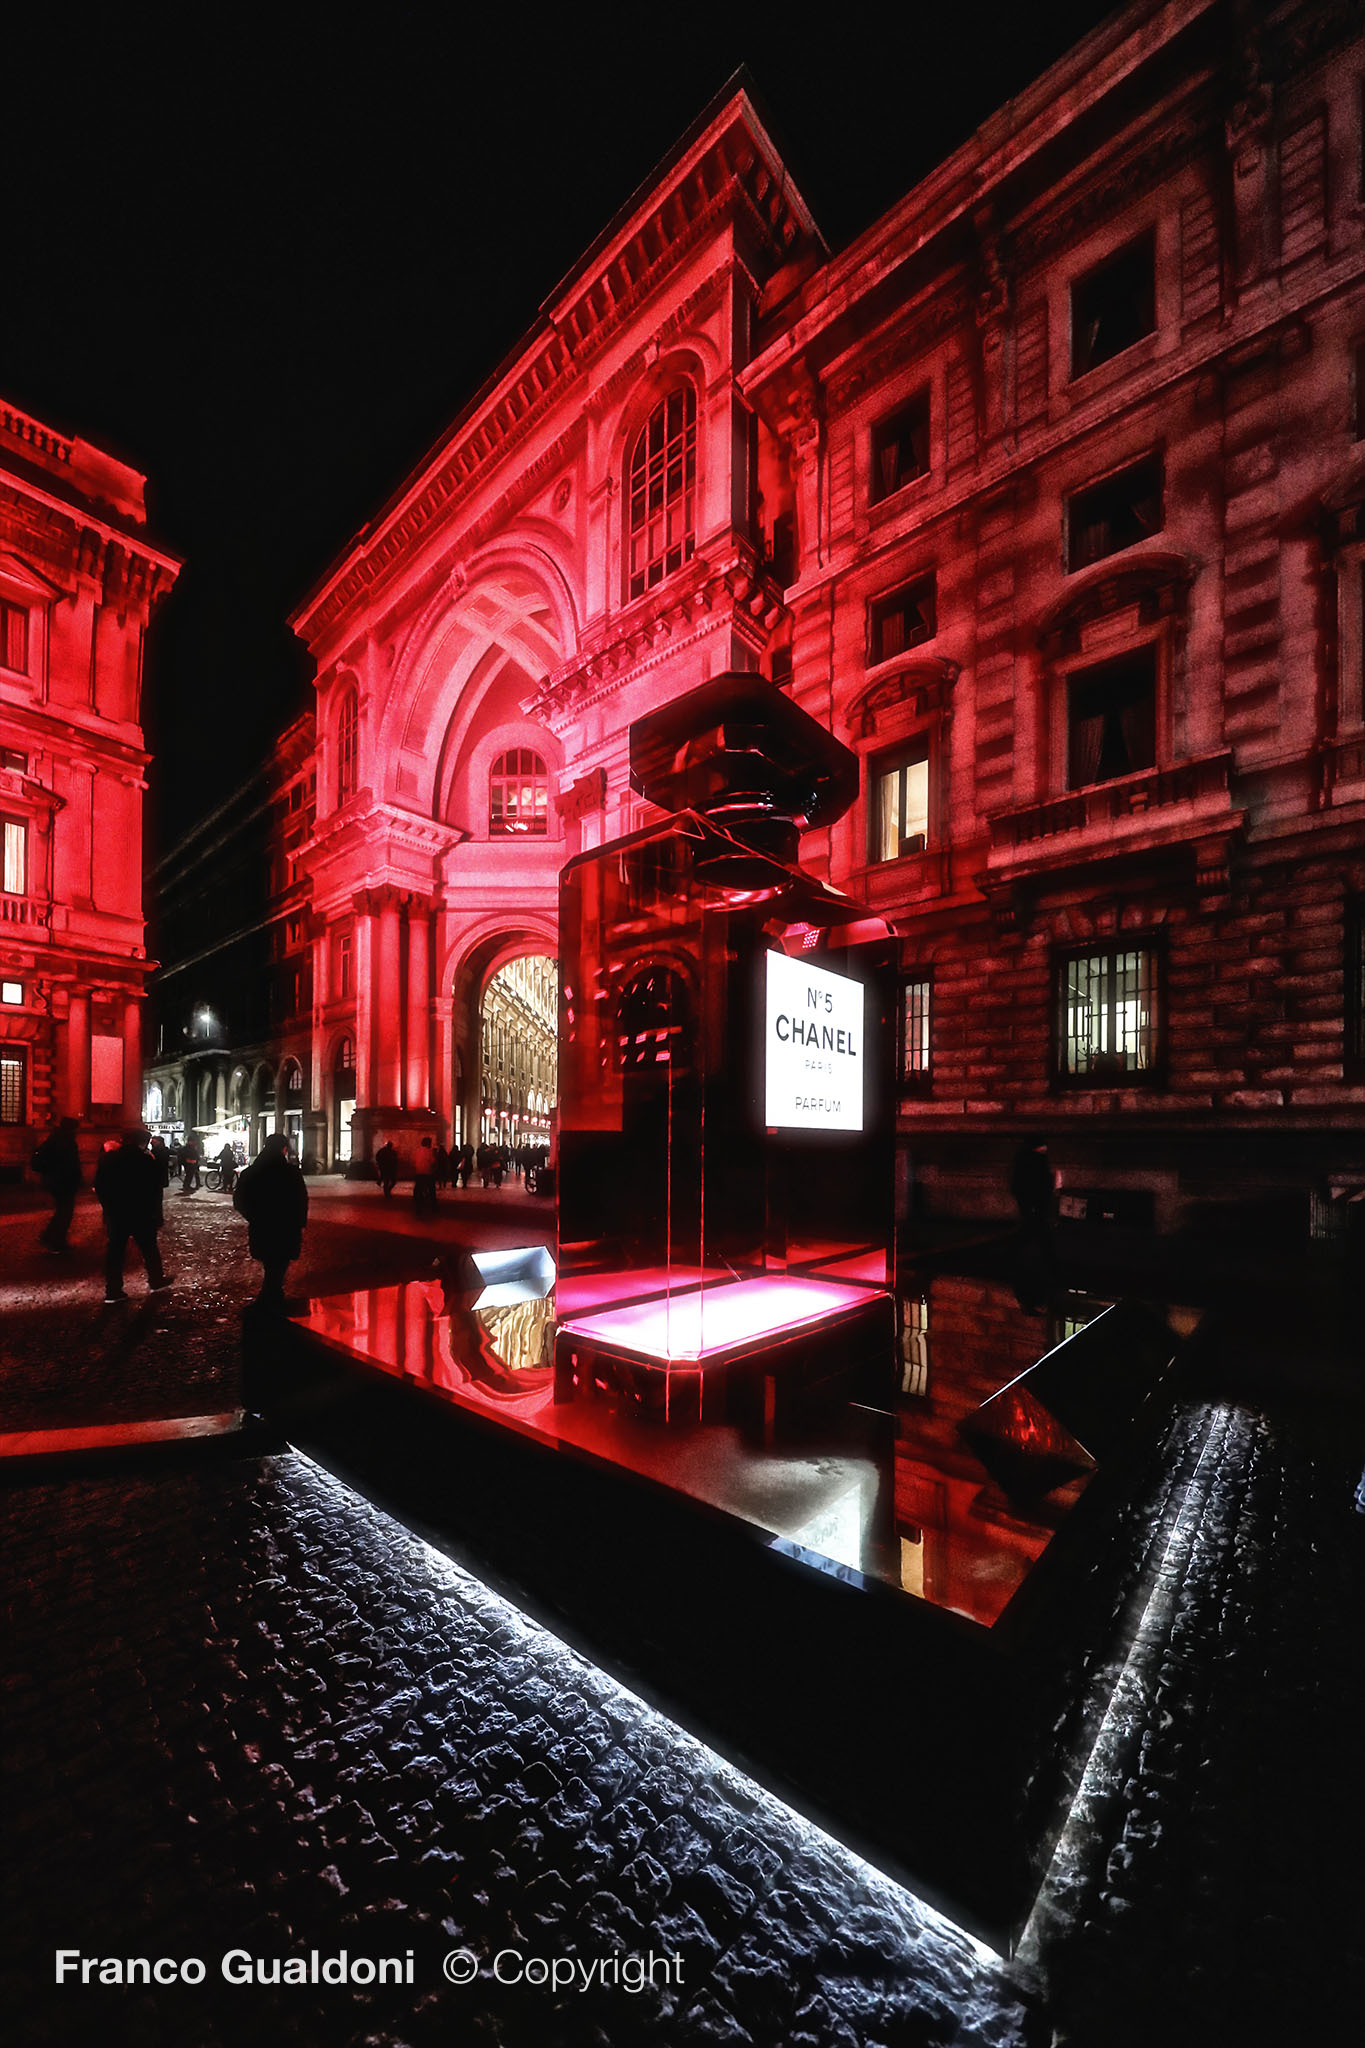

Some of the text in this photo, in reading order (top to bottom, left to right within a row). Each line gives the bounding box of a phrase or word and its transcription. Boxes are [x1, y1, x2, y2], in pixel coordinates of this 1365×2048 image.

[776, 1014, 857, 1057] CHANEL
[805, 1059, 833, 1075] PARIS
[795, 1096, 842, 1113] PARFUM
